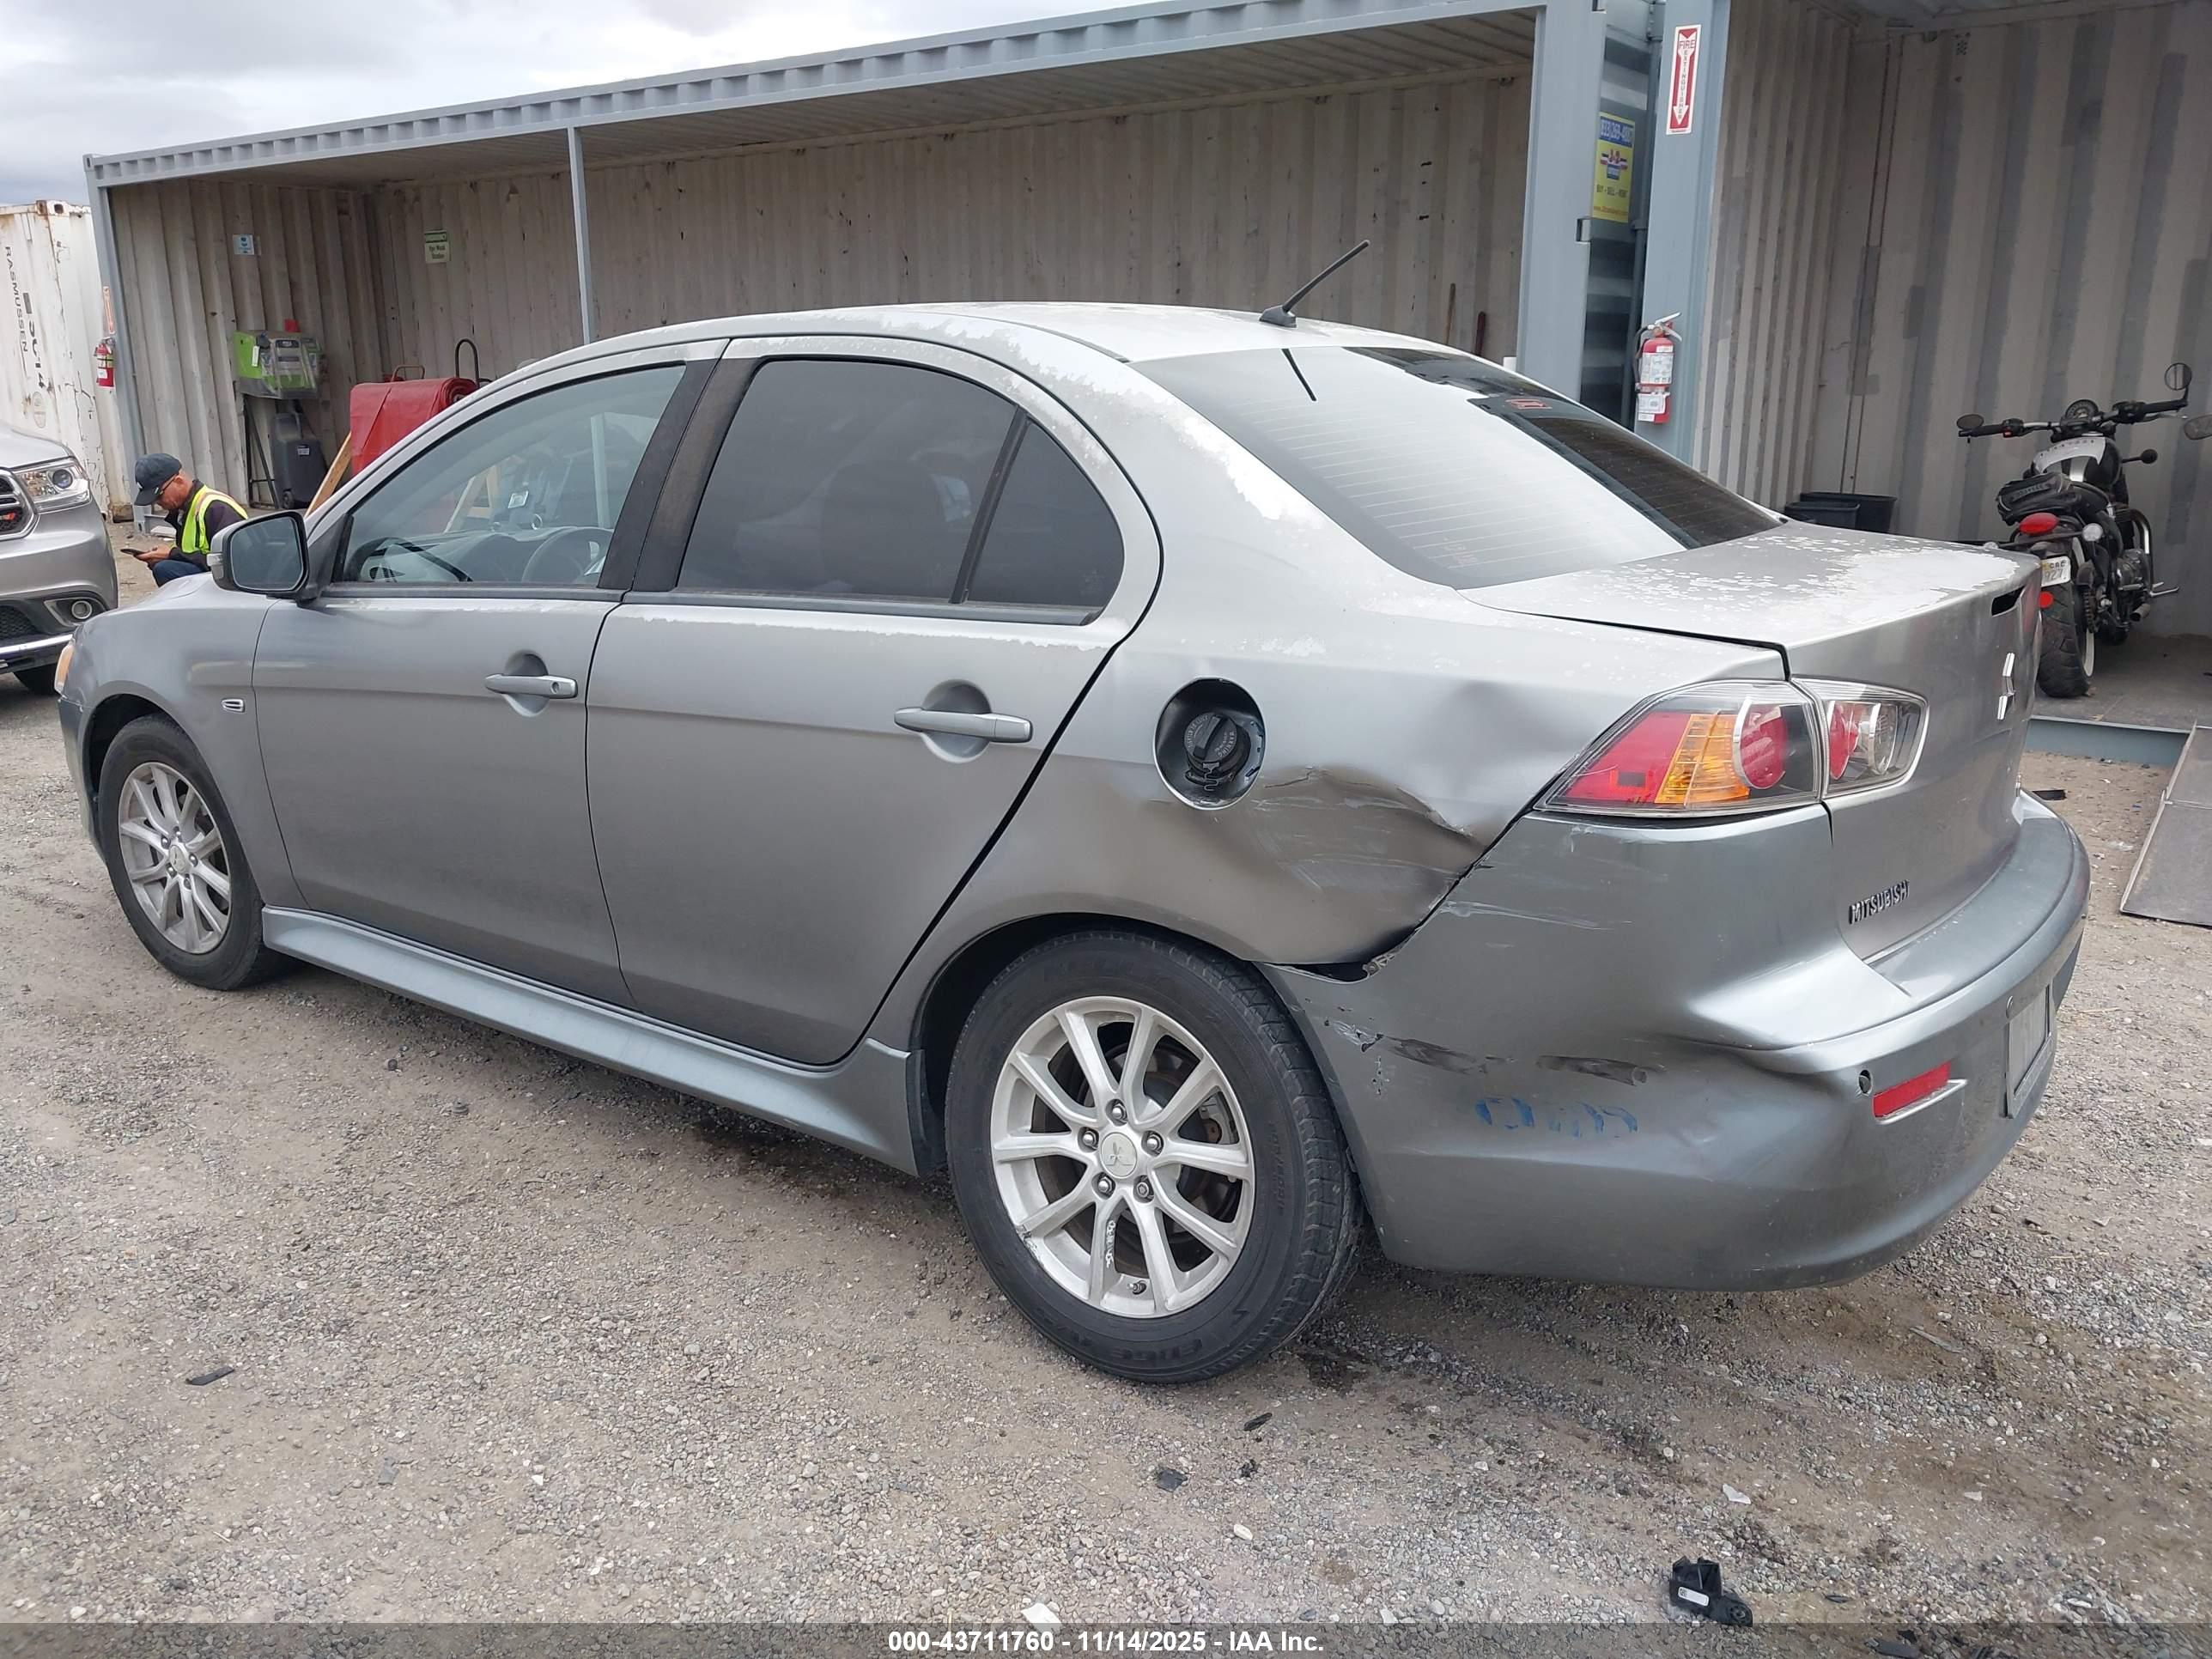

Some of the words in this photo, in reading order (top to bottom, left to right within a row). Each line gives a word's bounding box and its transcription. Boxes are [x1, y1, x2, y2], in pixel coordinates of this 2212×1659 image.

[1678, 40, 1696, 50] FIRE
[5, 246, 29, 354] RASMUSSEN
[1849, 879, 1910, 925] MITSUBISHI
